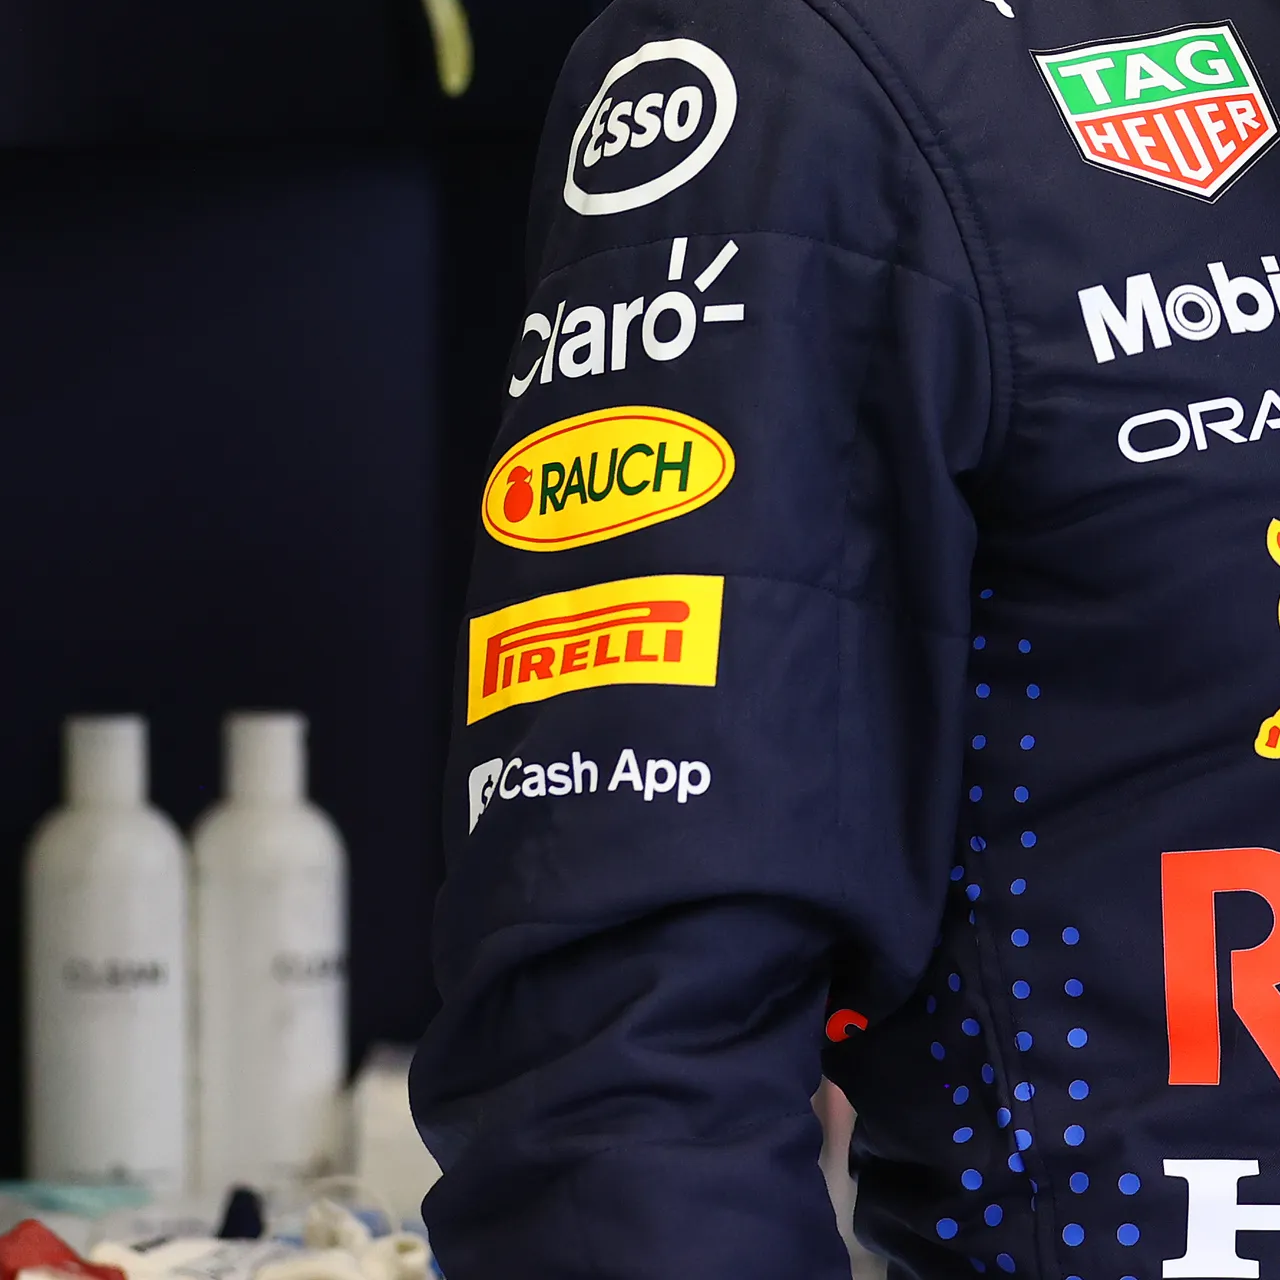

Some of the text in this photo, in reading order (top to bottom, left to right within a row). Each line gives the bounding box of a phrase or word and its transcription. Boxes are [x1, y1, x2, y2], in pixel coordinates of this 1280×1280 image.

[1057, 39, 1234, 106] TAG
[1084, 99, 1262, 182] HEUER
[539, 440, 693, 516] RAUCH
[482, 600, 690, 698] PIRELLI
[499, 748, 712, 804] Cash App
